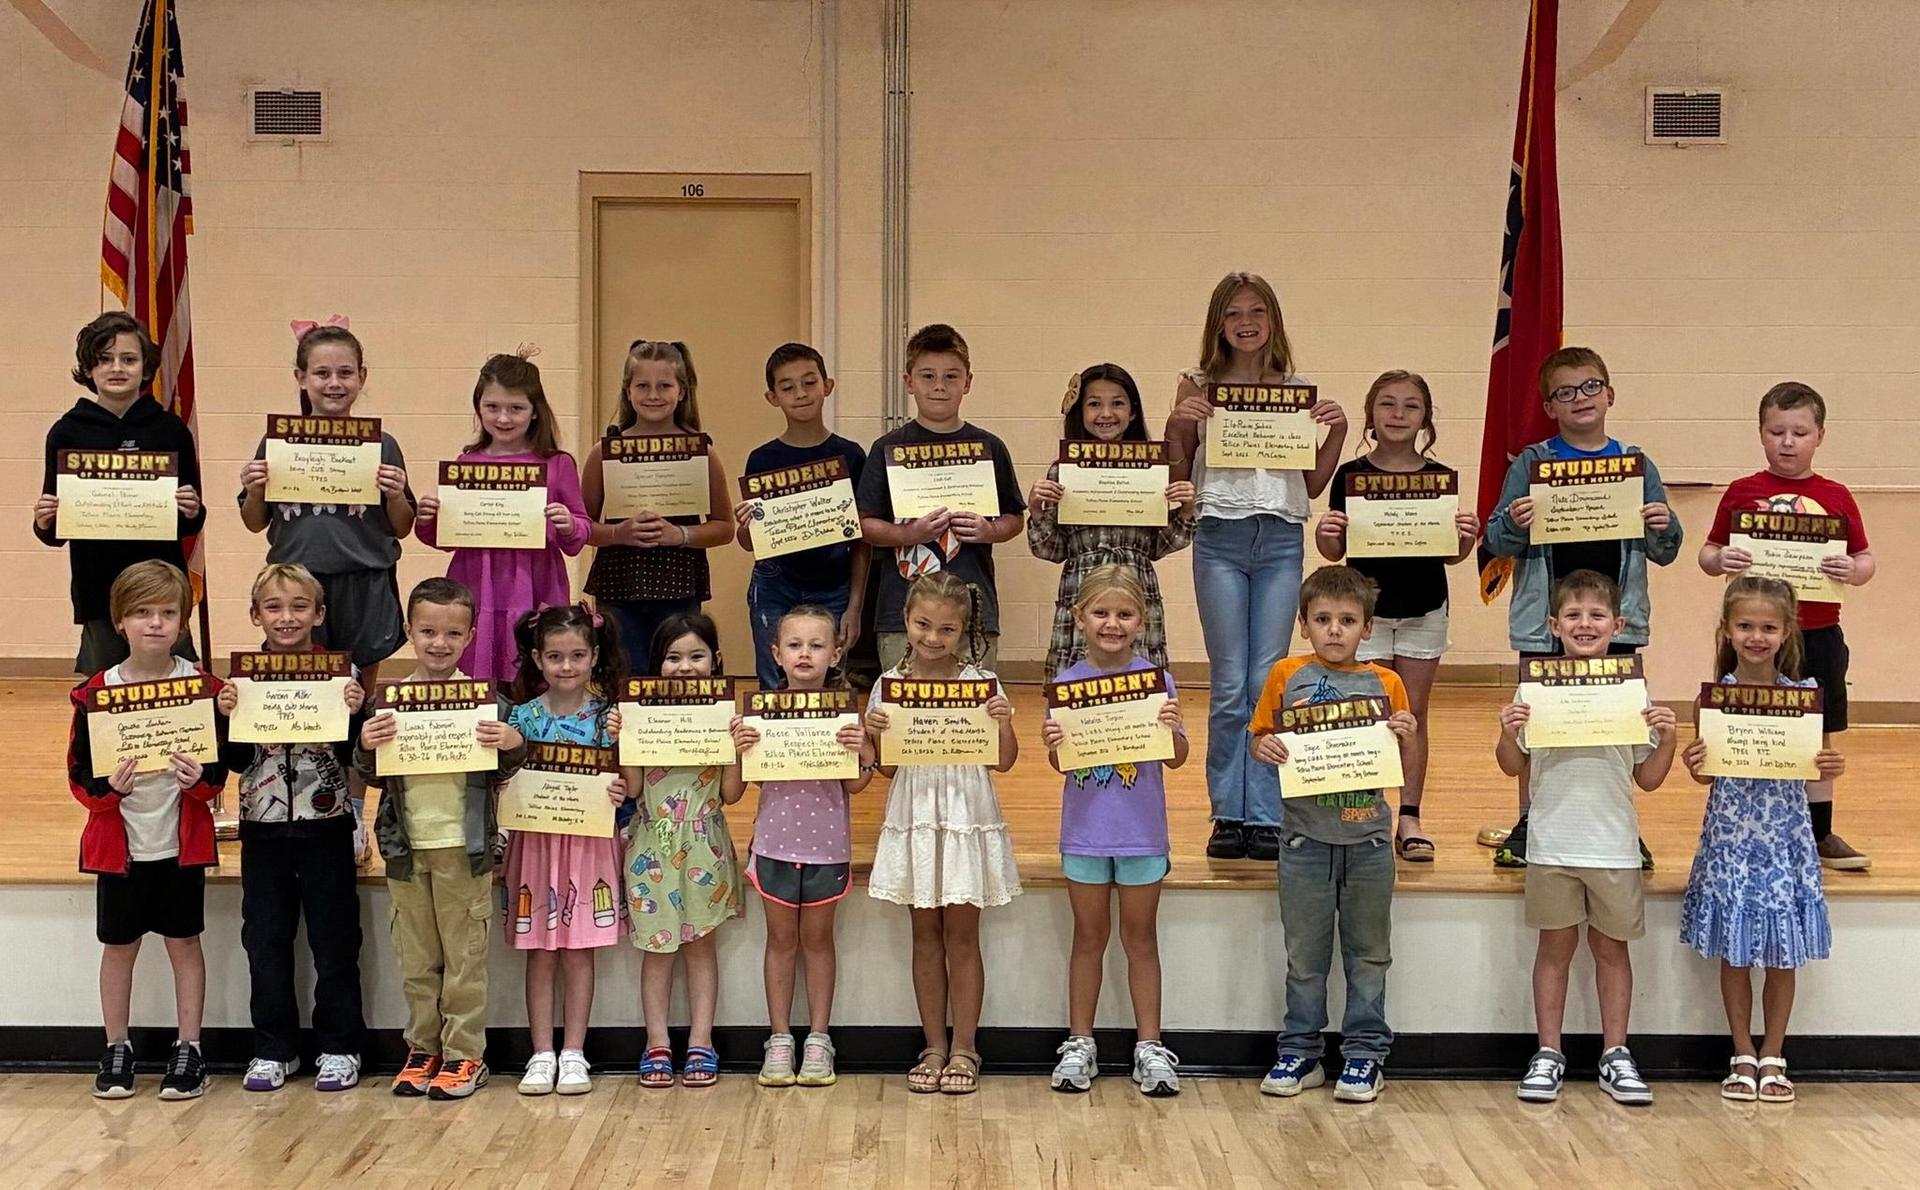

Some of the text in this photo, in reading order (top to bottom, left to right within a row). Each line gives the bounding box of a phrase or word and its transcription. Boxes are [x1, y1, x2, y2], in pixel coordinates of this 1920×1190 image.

[681, 184, 704, 197] 106
[1217, 387, 1309, 403] STUDENT
[276, 418, 373, 437] STUDENT
[610, 436, 700, 454] STUDENT
[893, 443, 984, 462] STUDENT
[1068, 443, 1161, 459] STUDENT
[67, 452, 169, 470] STUDENT
[1539, 457, 1636, 478] STUDENT
[447, 465, 540, 481] STUDENT
[748, 460, 840, 493] STUDENT
[778, 487, 796, 496] THE
[800, 480, 831, 490] MONTH
[1354, 474, 1450, 491] STUDENT
[1740, 513, 1840, 535] STUDENT
[241, 655, 343, 671] STUDENT
[1529, 658, 1634, 677] STUDENT
[96, 678, 202, 705] STUDENT
[386, 683, 489, 703] STUDENT
[629, 680, 727, 696] STUDENT
[890, 682, 989, 698] STUDENT
[1056, 672, 1156, 701] STUDENT
[154, 698, 190, 708] MONTH
[751, 693, 850, 710] STUDENT
[1088, 698, 1107, 706] THE
[1112, 692, 1146, 703] MONTH
[1711, 687, 1815, 707] STUDENT
[913, 717, 939, 725] Haven
[1338, 719, 1372, 728] MONTH
[565, 766, 597, 774] MONTH
